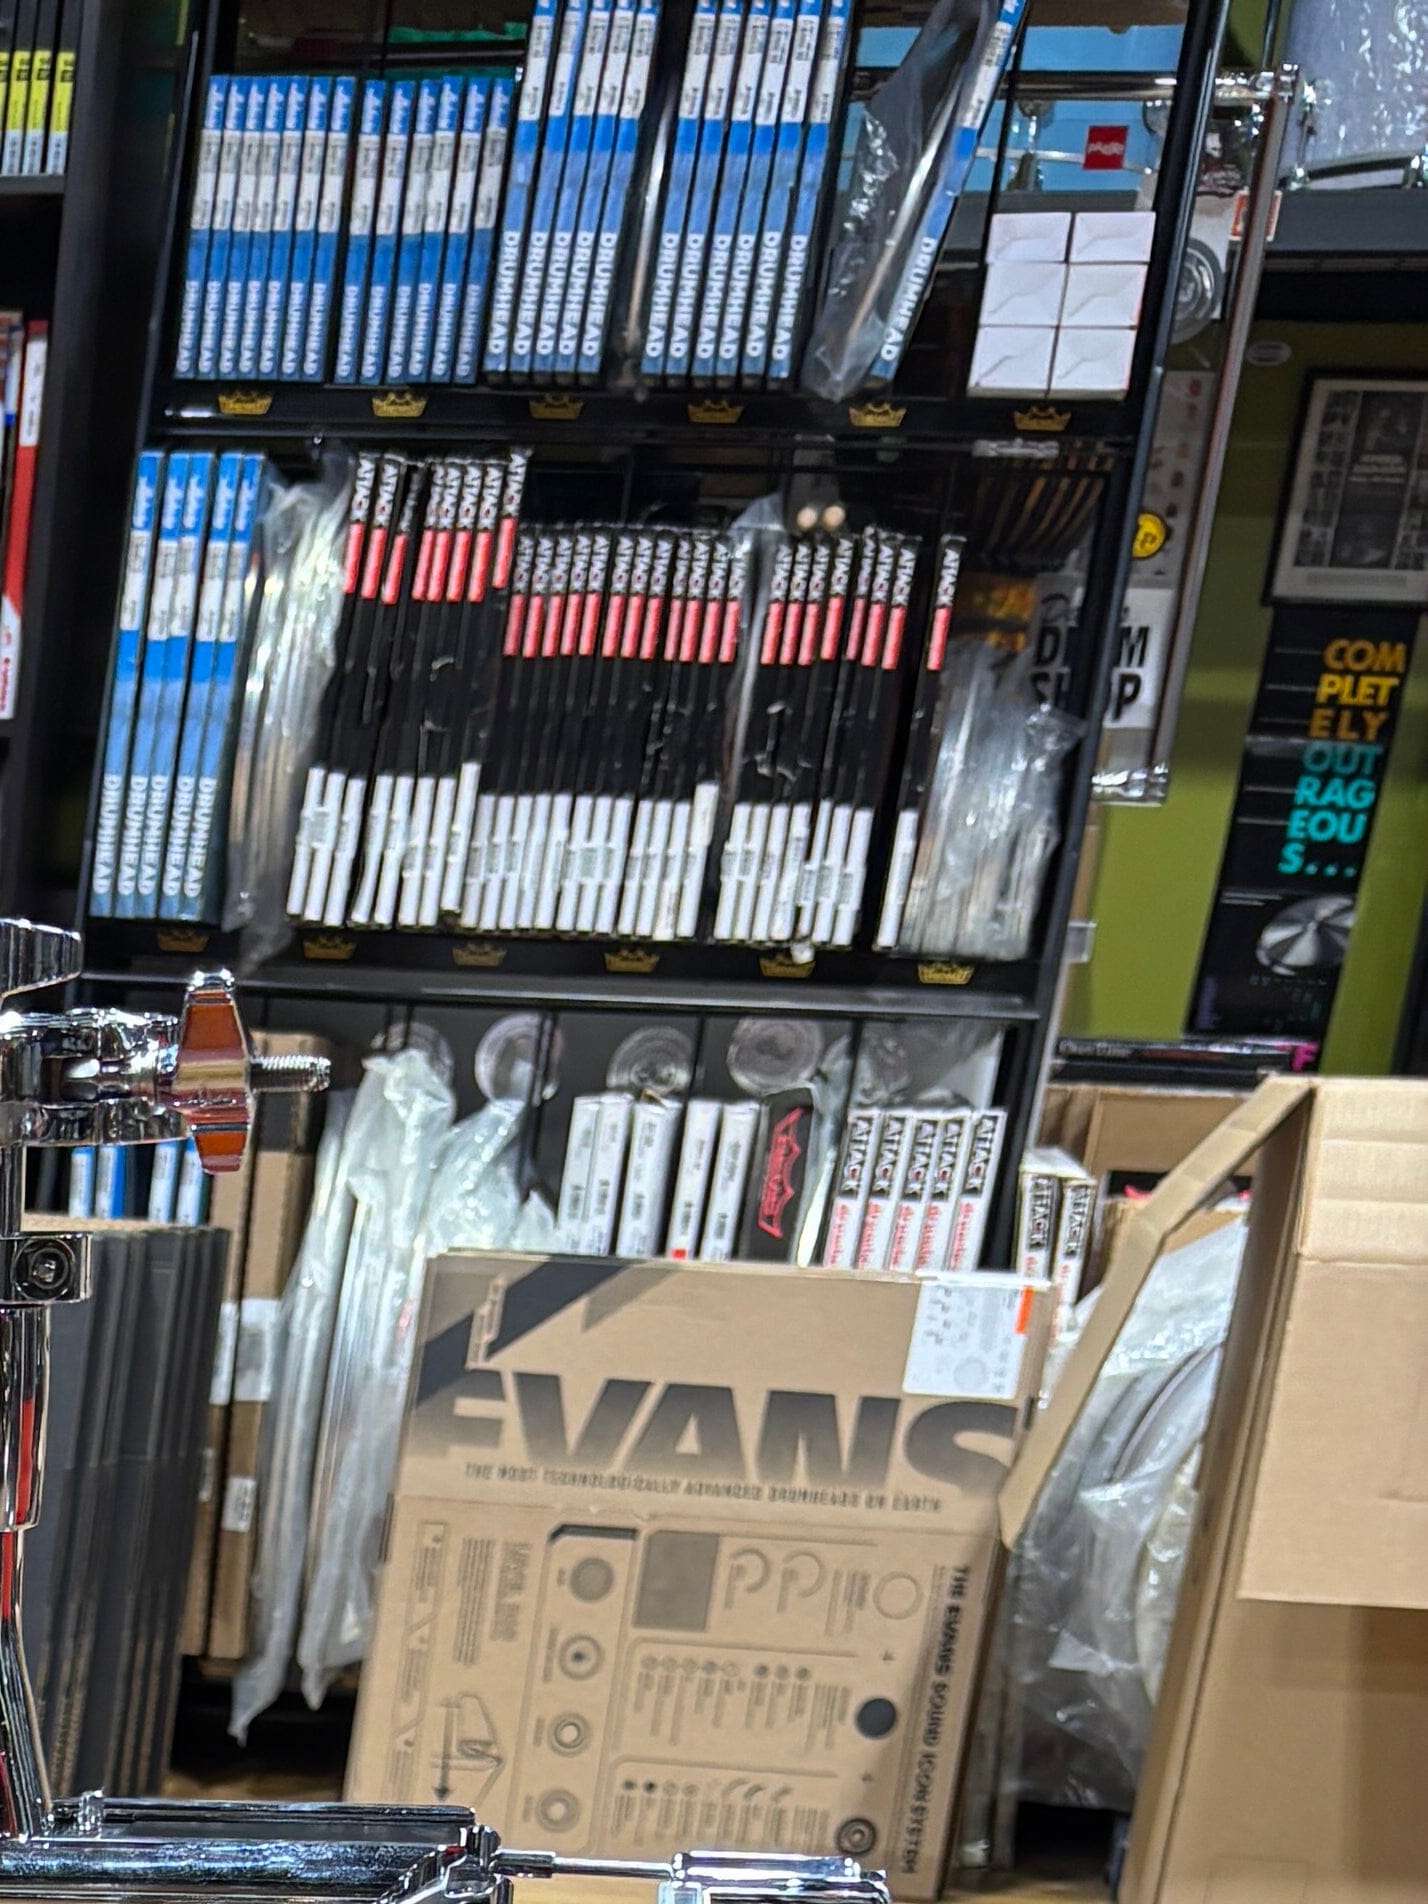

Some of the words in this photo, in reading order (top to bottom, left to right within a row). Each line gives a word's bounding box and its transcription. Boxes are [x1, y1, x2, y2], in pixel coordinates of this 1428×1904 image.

[488, 231, 521, 354] DRUMHEAD
[513, 231, 549, 355] DRUMHEAD
[535, 231, 572, 355] DRUMHEAD
[558, 231, 595, 356] DRUMHEAD
[582, 232, 619, 356] DRUMHEAD
[645, 234, 678, 357] DRUMHEAD
[668, 234, 702, 357] DRUMHEAD
[695, 235, 731, 358] DRUMHEAD
[718, 234, 755, 358] DRUMHEAD
[746, 231, 781, 357] DRUMHEAD
[772, 236, 808, 360] DRUMHEAD
[880, 236, 937, 360] DRUMHEAD
[1035, 626, 1149, 666] DM
[1315, 673, 1400, 707] PLET
[1323, 638, 1406, 673] COM
[1302, 742, 1383, 775] OUT
[1308, 708, 1389, 742] ELY
[91, 775, 120, 895] DRUMHEAD
[117, 776, 148, 895] DRUMHEAD
[137, 776, 169, 895] DRUMHEAD
[162, 776, 195, 896] DRUMHEAD
[183, 777, 216, 898] DRUMHEAD
[1286, 809, 1368, 843] EOU
[1294, 775, 1377, 810] RAG
[964, 1116, 994, 1190] ATTACK
[412, 1368, 1018, 1497] EVANS
[935, 1604, 961, 1676] EVANS
[950, 1565, 970, 1598] THE
[923, 1681, 948, 1747] SOUND
[901, 1803, 927, 1874] SYSTEM
